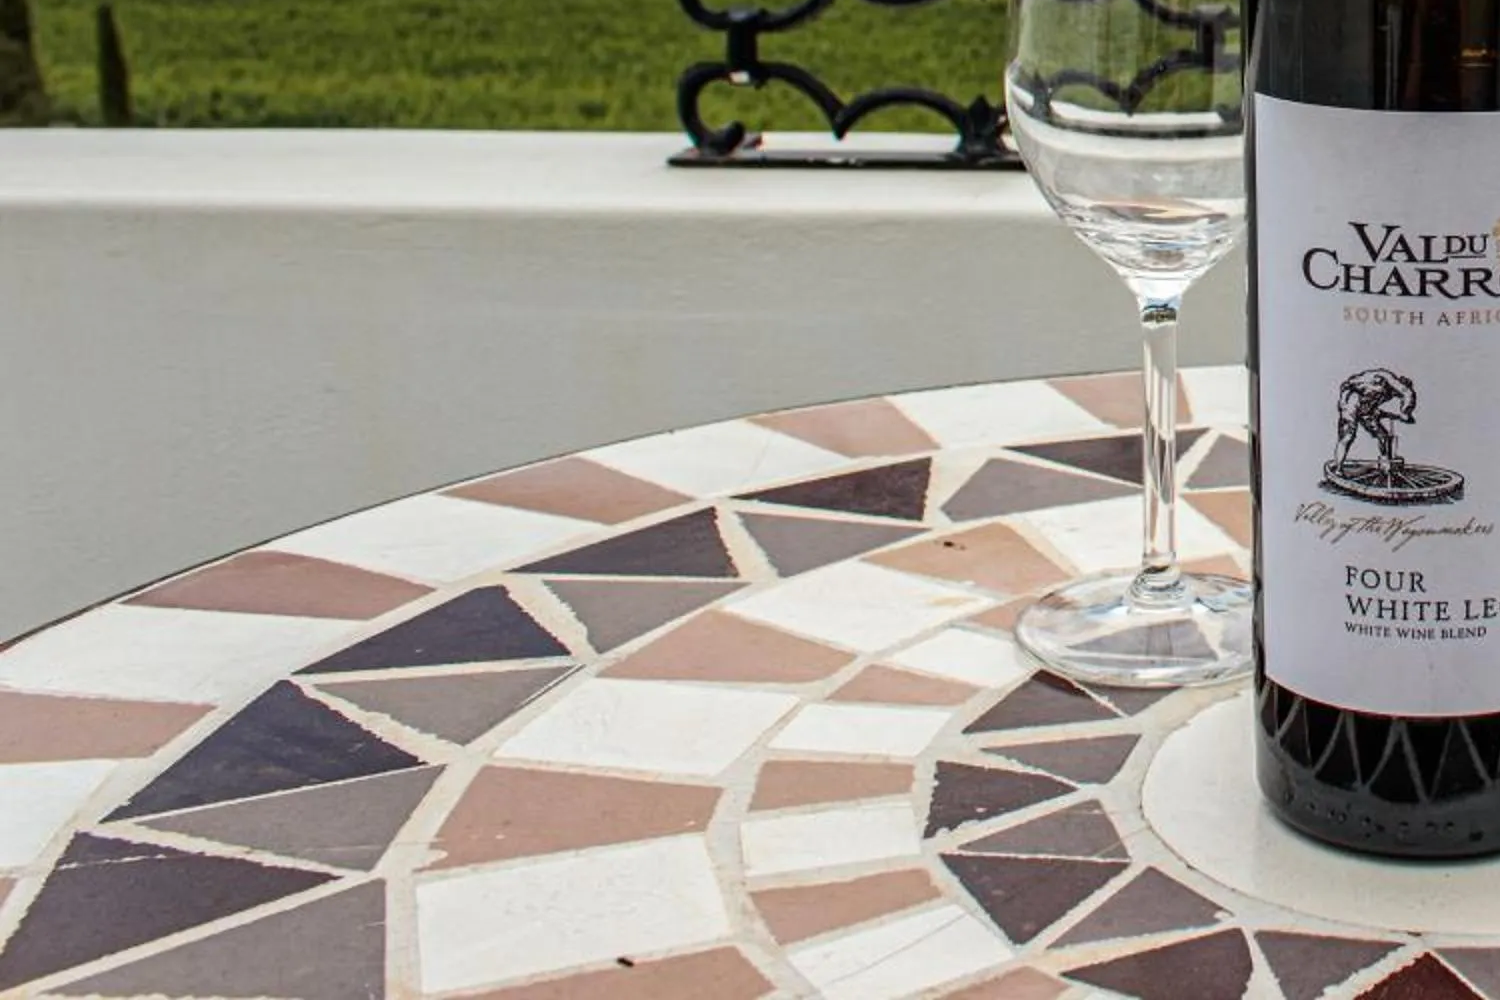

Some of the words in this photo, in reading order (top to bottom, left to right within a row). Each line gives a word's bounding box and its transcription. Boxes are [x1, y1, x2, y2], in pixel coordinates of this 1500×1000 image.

[1349, 222, 1448, 264] VAL
[1445, 233, 1489, 256] DU
[1343, 306, 1424, 325] SOUTH
[1345, 565, 1426, 593] FOUR
[1345, 595, 1451, 621] WHITE
[1345, 622, 1391, 638] WHITE
[1396, 626, 1436, 640] WINE
[1441, 626, 1487, 640] BLEND
